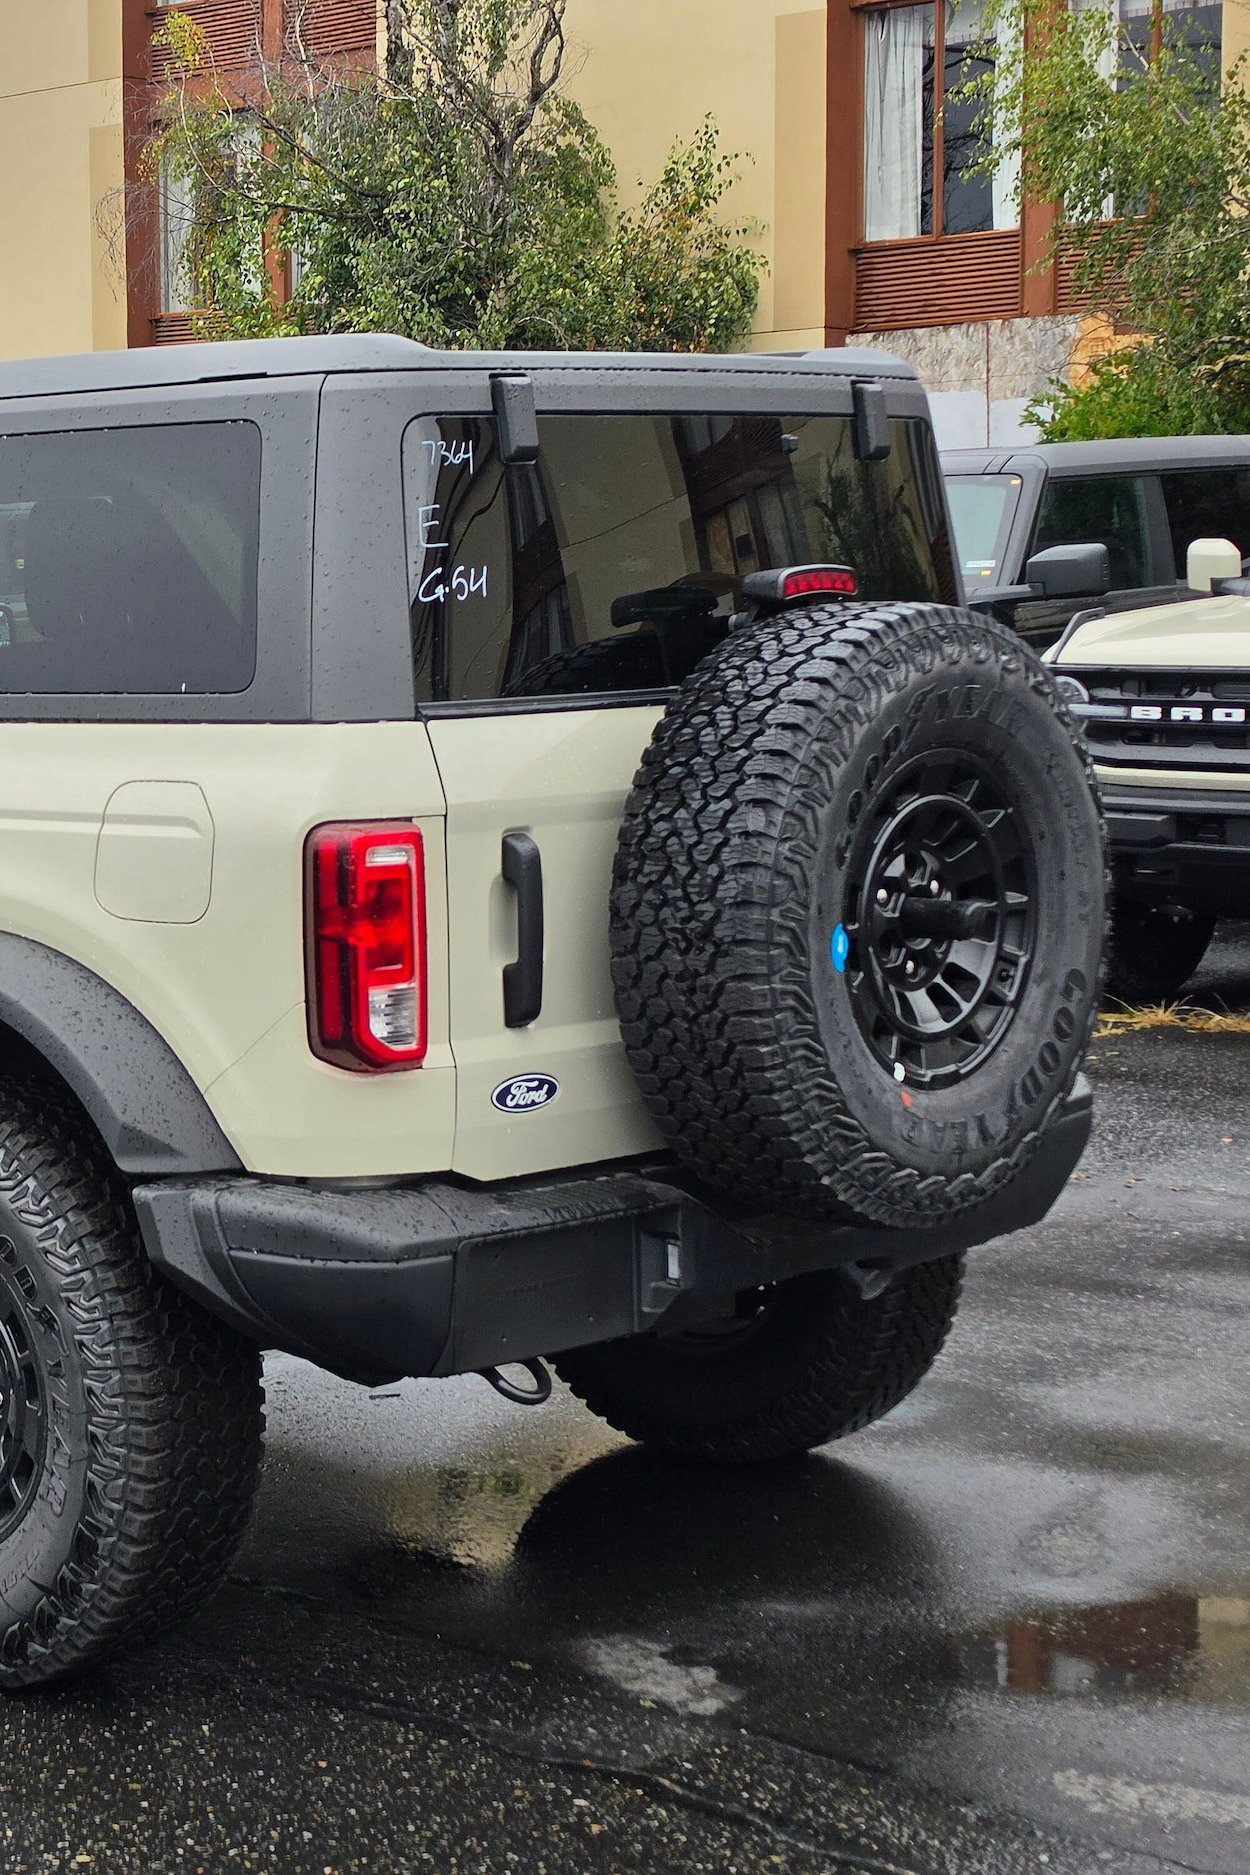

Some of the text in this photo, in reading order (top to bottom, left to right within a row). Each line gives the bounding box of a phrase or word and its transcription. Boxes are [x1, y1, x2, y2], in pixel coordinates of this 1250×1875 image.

[421, 439, 474, 475] 7364
[418, 504, 449, 548] E
[506, 1080, 549, 1107] Ford
